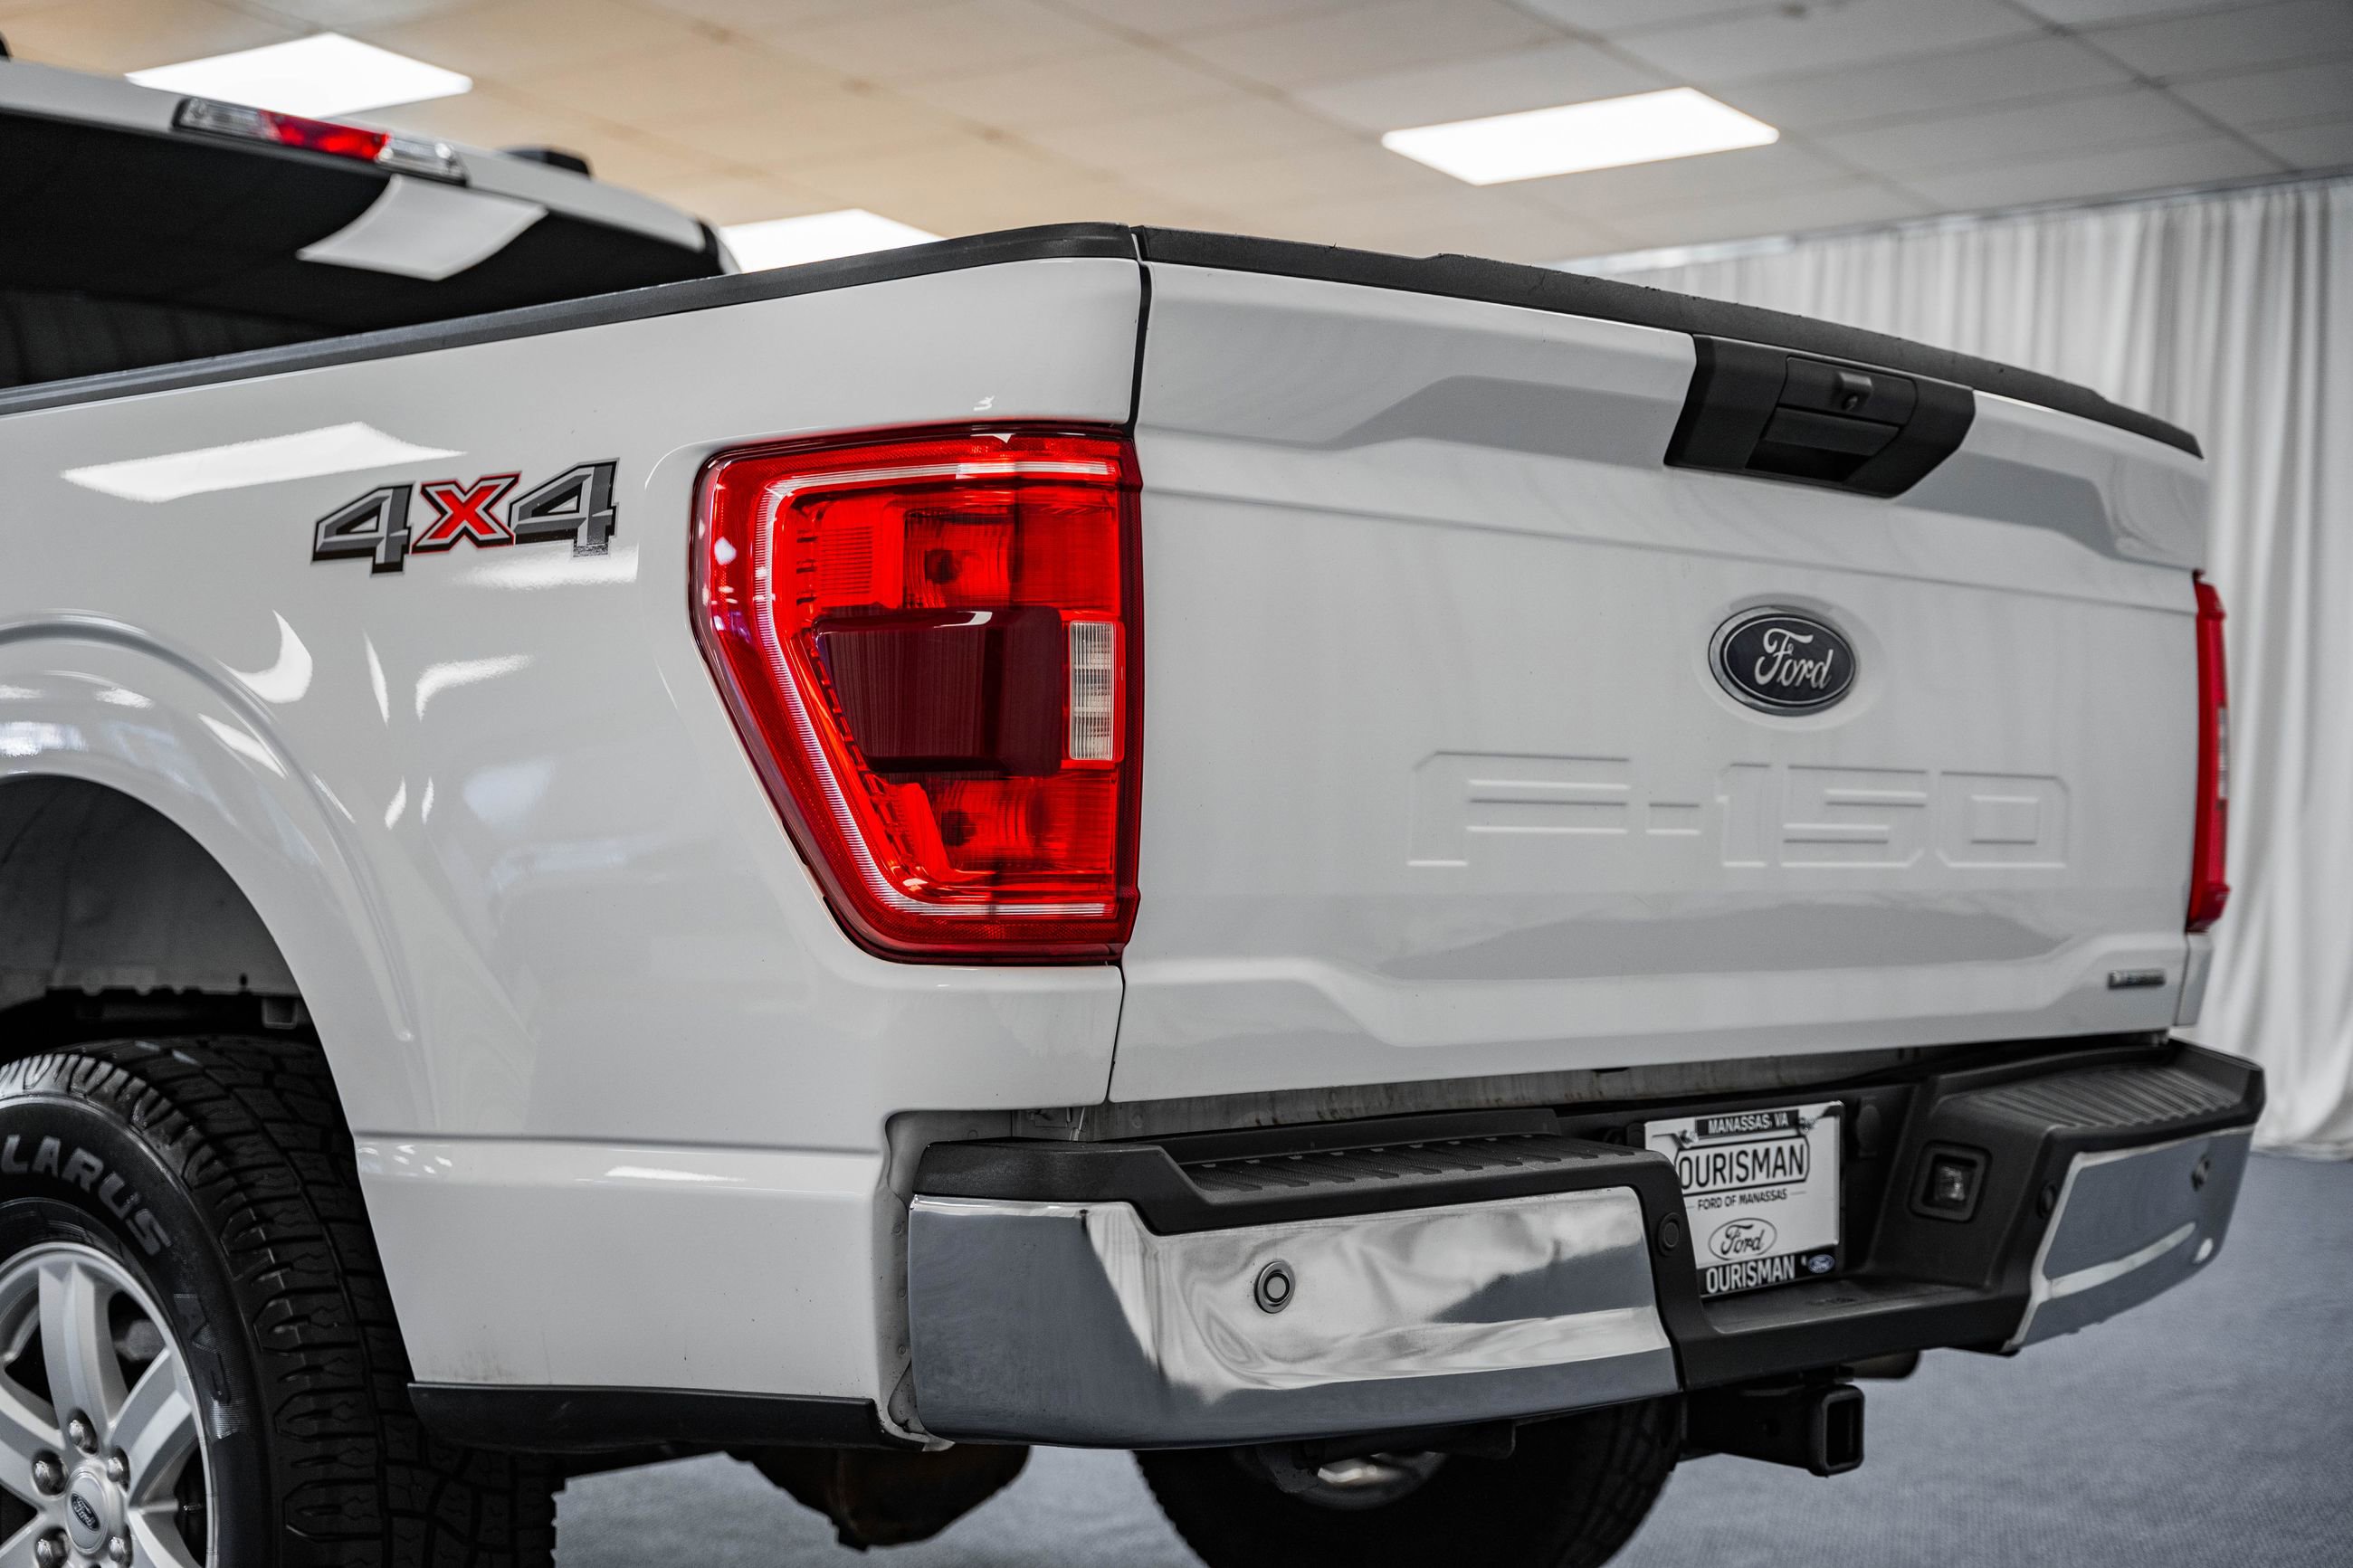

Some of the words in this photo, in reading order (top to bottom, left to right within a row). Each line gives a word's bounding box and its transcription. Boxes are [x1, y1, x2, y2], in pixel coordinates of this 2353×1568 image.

[1754, 627, 1834, 689] Ford
[1407, 752, 2071, 868] F-150
[1774, 1111, 1789, 1127] VA
[1679, 1144, 1805, 1191] OURISMAN
[1, 1135, 173, 1257] LARUS
[1698, 1196, 1723, 1212] FORD
[1724, 1194, 1738, 1208] OF
[1739, 1188, 1788, 1205] MANASSAS
[1720, 1223, 1766, 1256] Ford
[1706, 1254, 1796, 1294] OURISMAN
